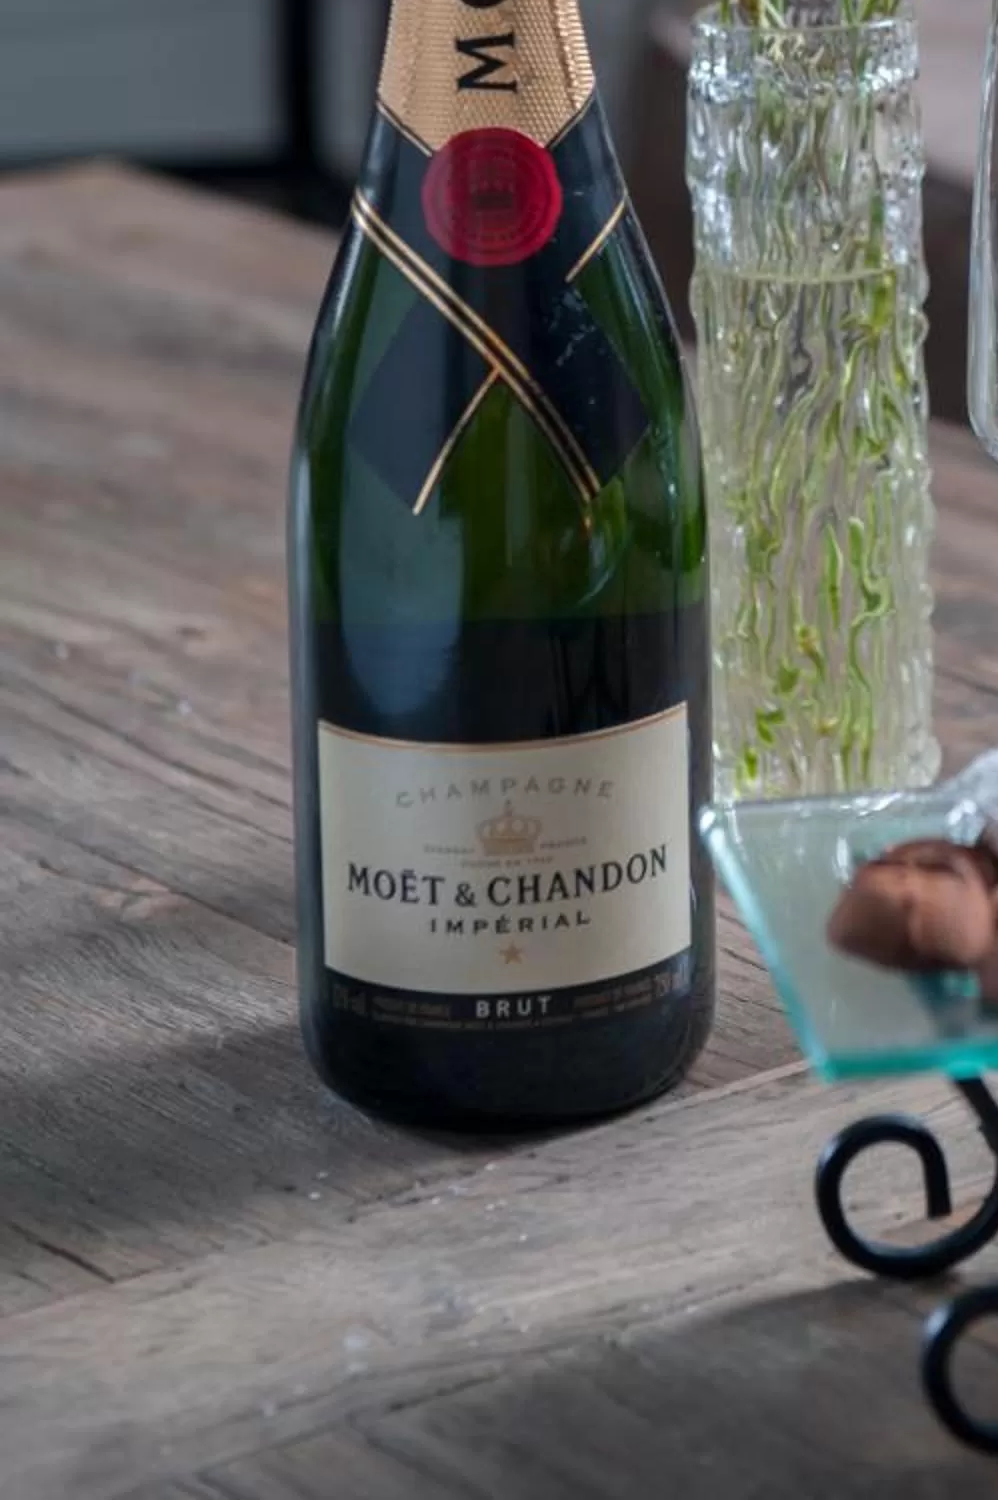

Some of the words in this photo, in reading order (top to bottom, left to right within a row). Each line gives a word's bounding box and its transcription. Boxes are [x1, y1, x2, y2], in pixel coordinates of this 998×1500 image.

[396, 777, 616, 809] CHAMPAGNE
[347, 862, 445, 905] MOËT
[454, 883, 477, 908] &
[487, 844, 669, 908] CHANDON
[430, 910, 592, 935] IMPÉRIAL
[475, 995, 553, 1019] BRUT
